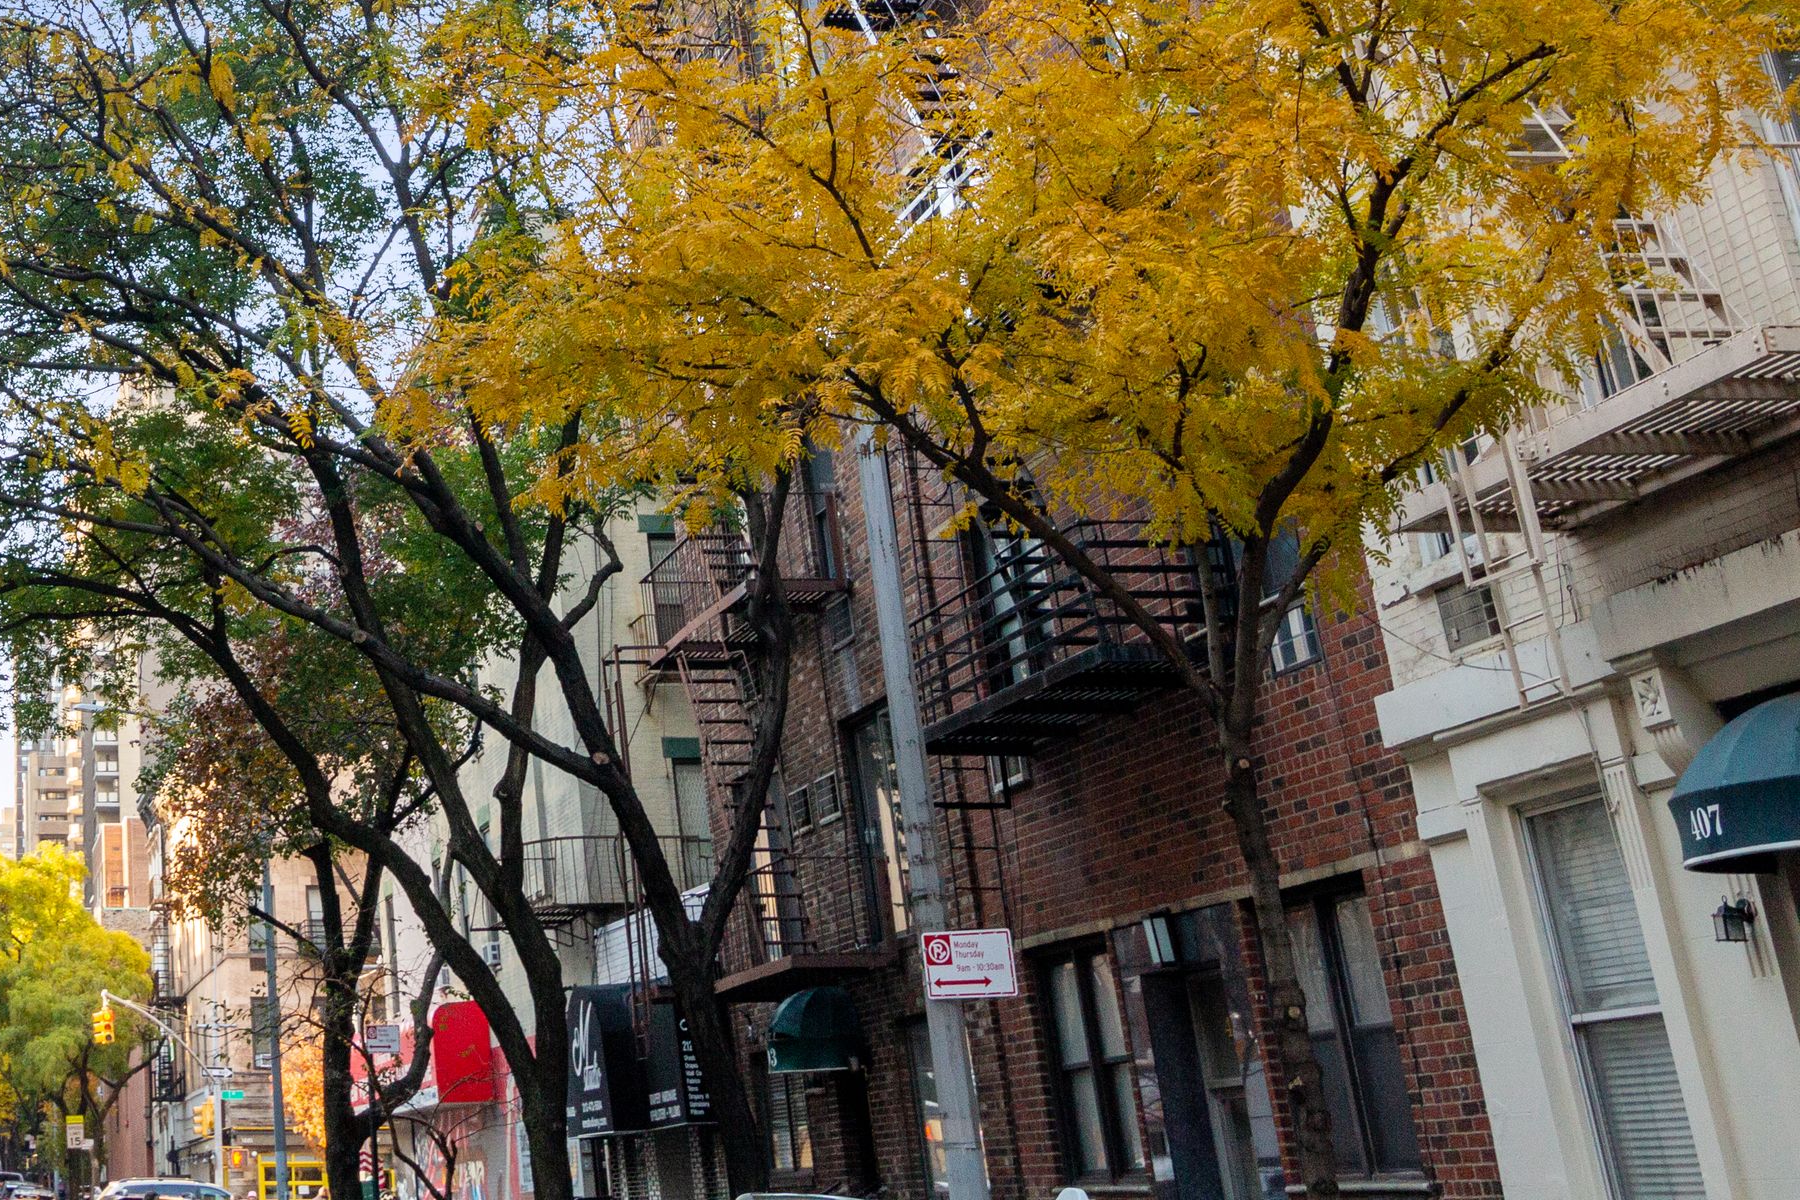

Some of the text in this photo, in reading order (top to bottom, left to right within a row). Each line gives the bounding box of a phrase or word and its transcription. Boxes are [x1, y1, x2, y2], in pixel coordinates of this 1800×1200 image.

[1690, 804, 1722, 841] 407
[953, 940, 979, 949] Monday
[955, 950, 985, 959] Thursday
[956, 964, 971, 972] 9am
[976, 962, 1004, 971] 10:30am
[70, 1137, 81, 1146] 15
